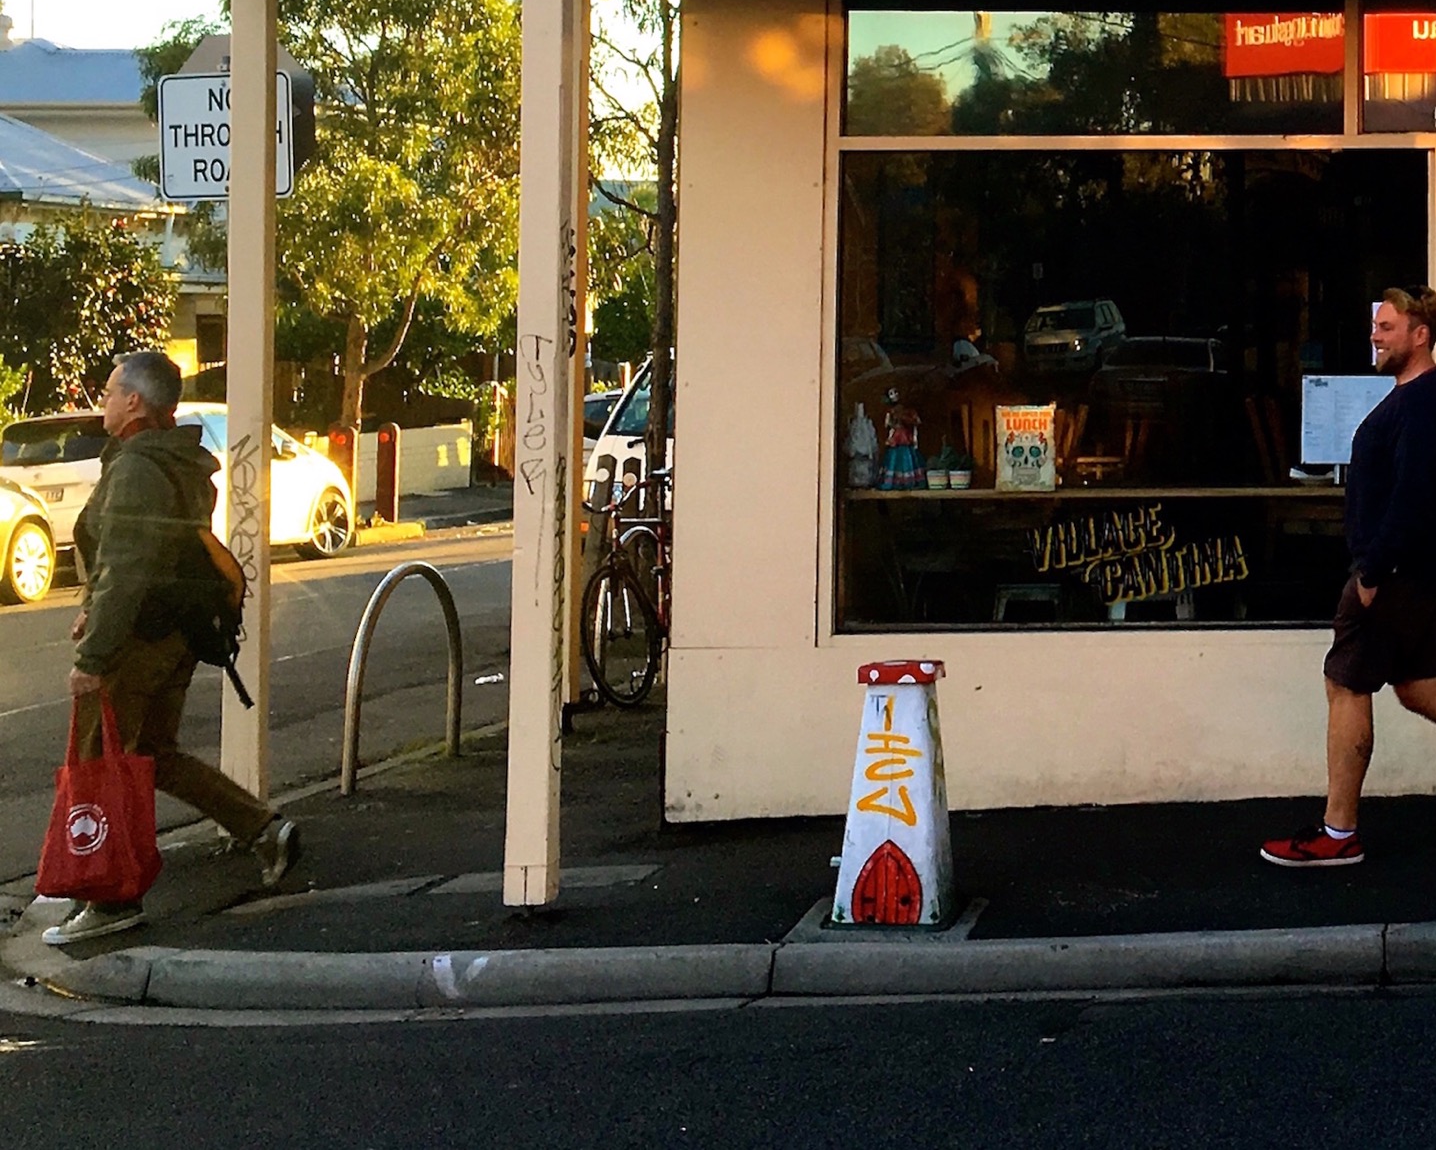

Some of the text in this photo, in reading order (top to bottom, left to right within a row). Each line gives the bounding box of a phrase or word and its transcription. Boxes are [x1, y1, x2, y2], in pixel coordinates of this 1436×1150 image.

[169, 120, 282, 148] THROH
[193, 158, 230, 182] RO
[1006, 418, 1047, 431] LUNCH
[1026, 502, 1164, 573] VILLAGE
